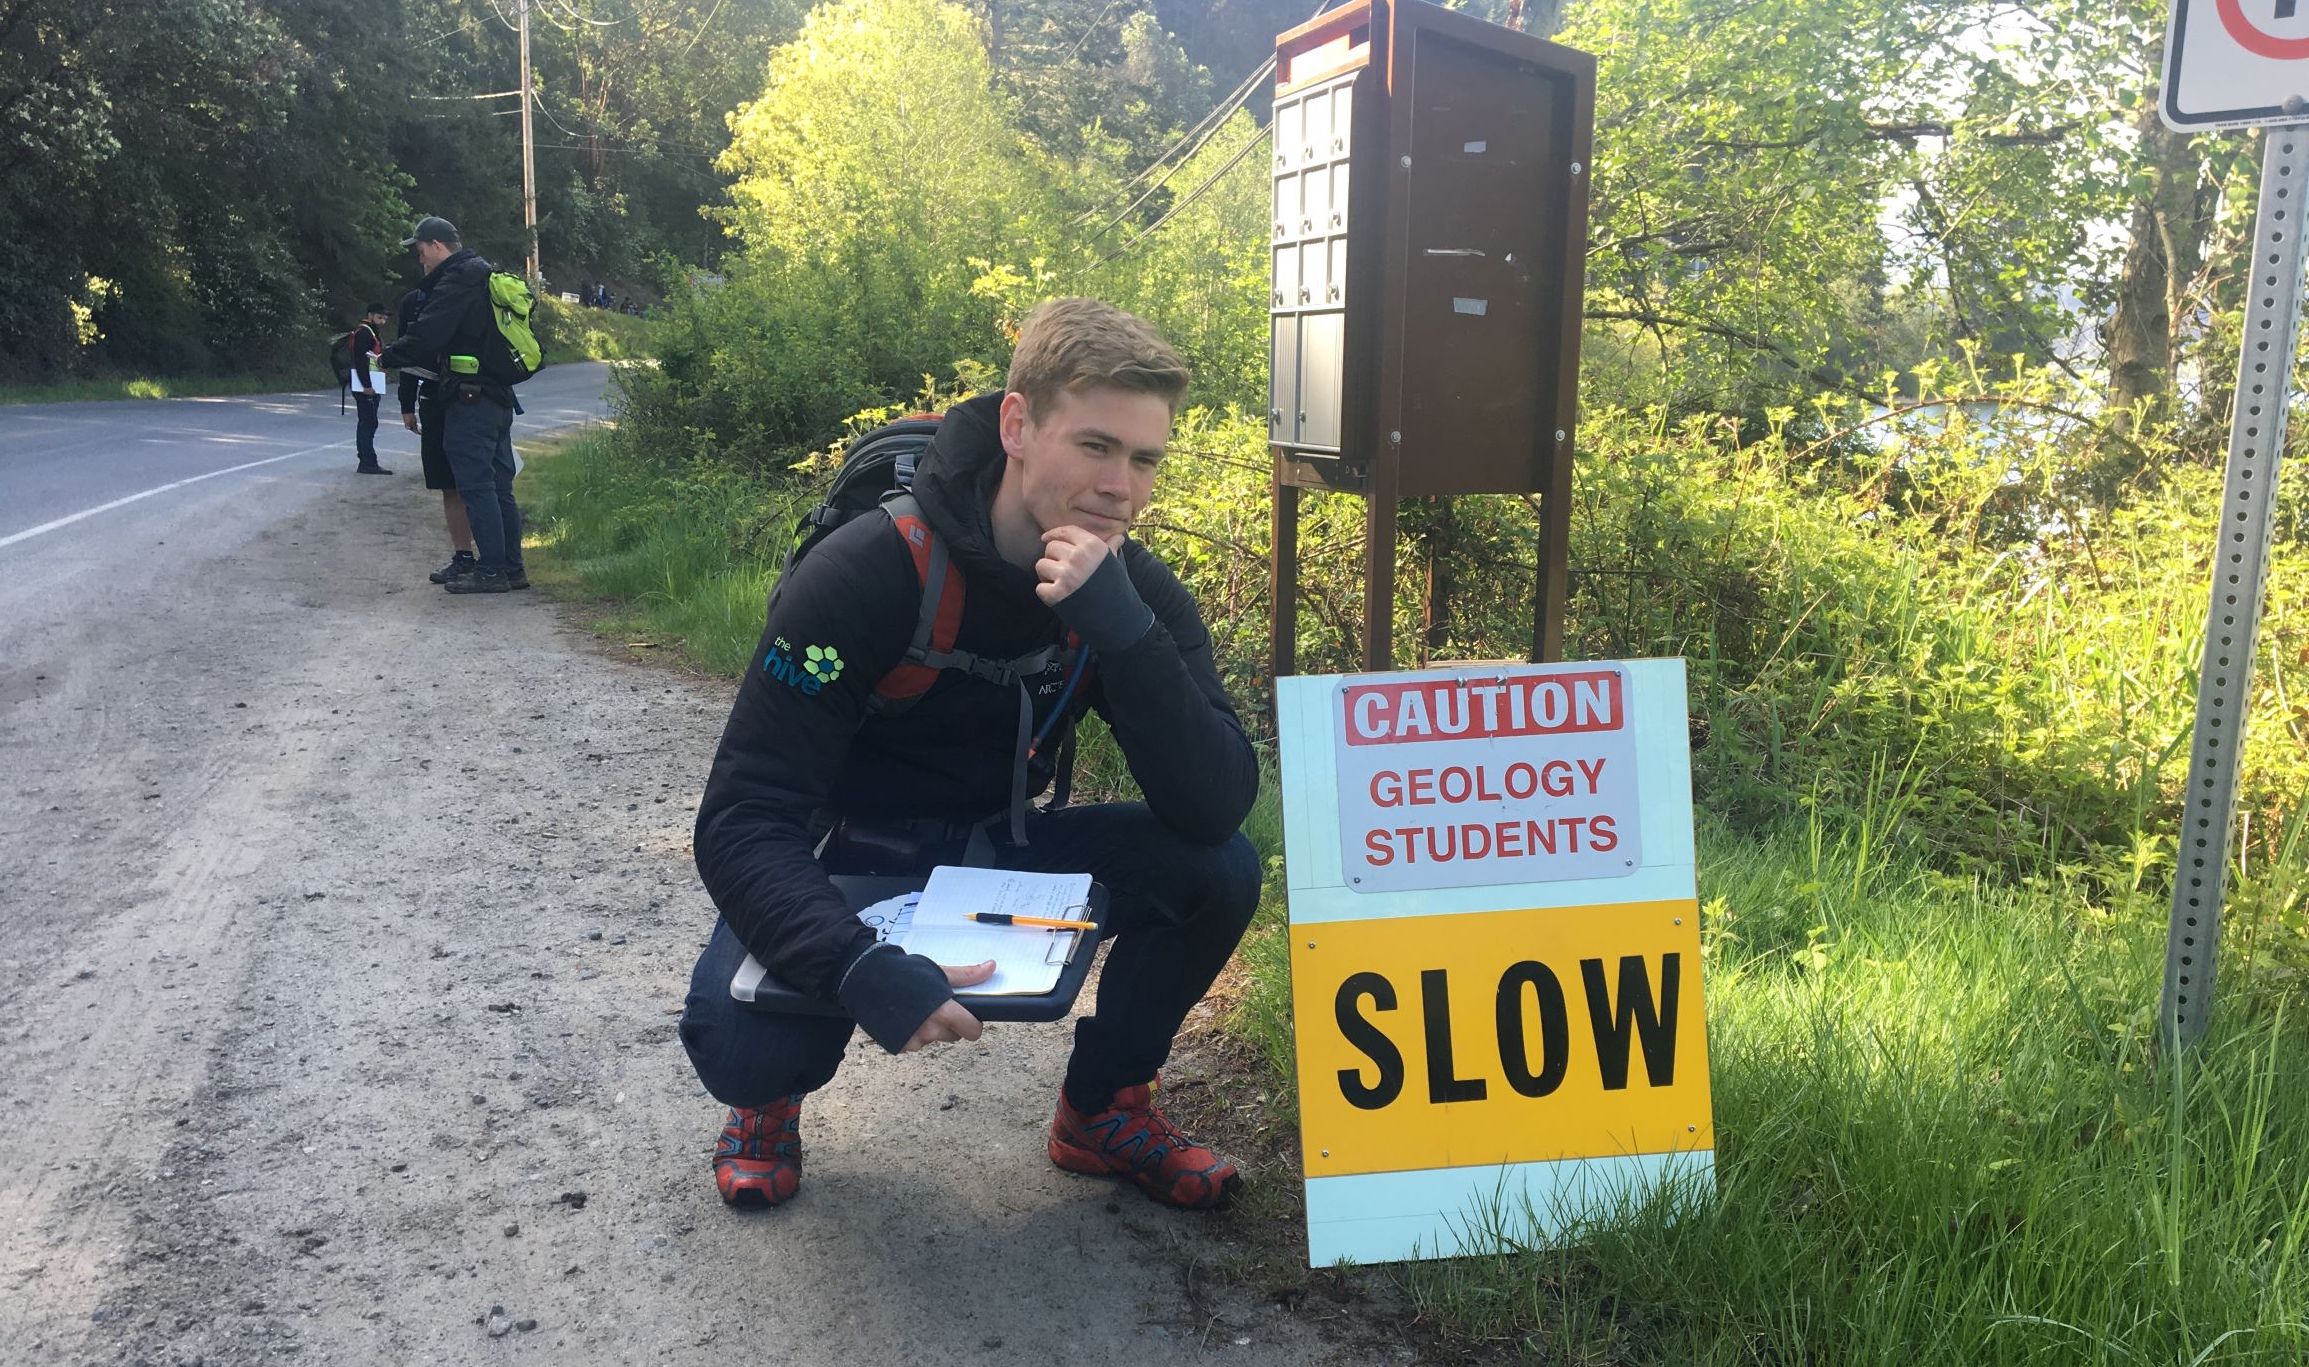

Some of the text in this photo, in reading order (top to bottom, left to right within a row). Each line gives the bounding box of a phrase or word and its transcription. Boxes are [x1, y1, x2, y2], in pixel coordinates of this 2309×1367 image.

[774, 636, 791, 651] the
[763, 646, 822, 696] hive
[1352, 680, 1613, 739] CAUTION
[1369, 758, 1606, 808] GEOLOGY
[1365, 815, 1618, 866] STUDENTS
[1334, 952, 1680, 1110] SLOW
